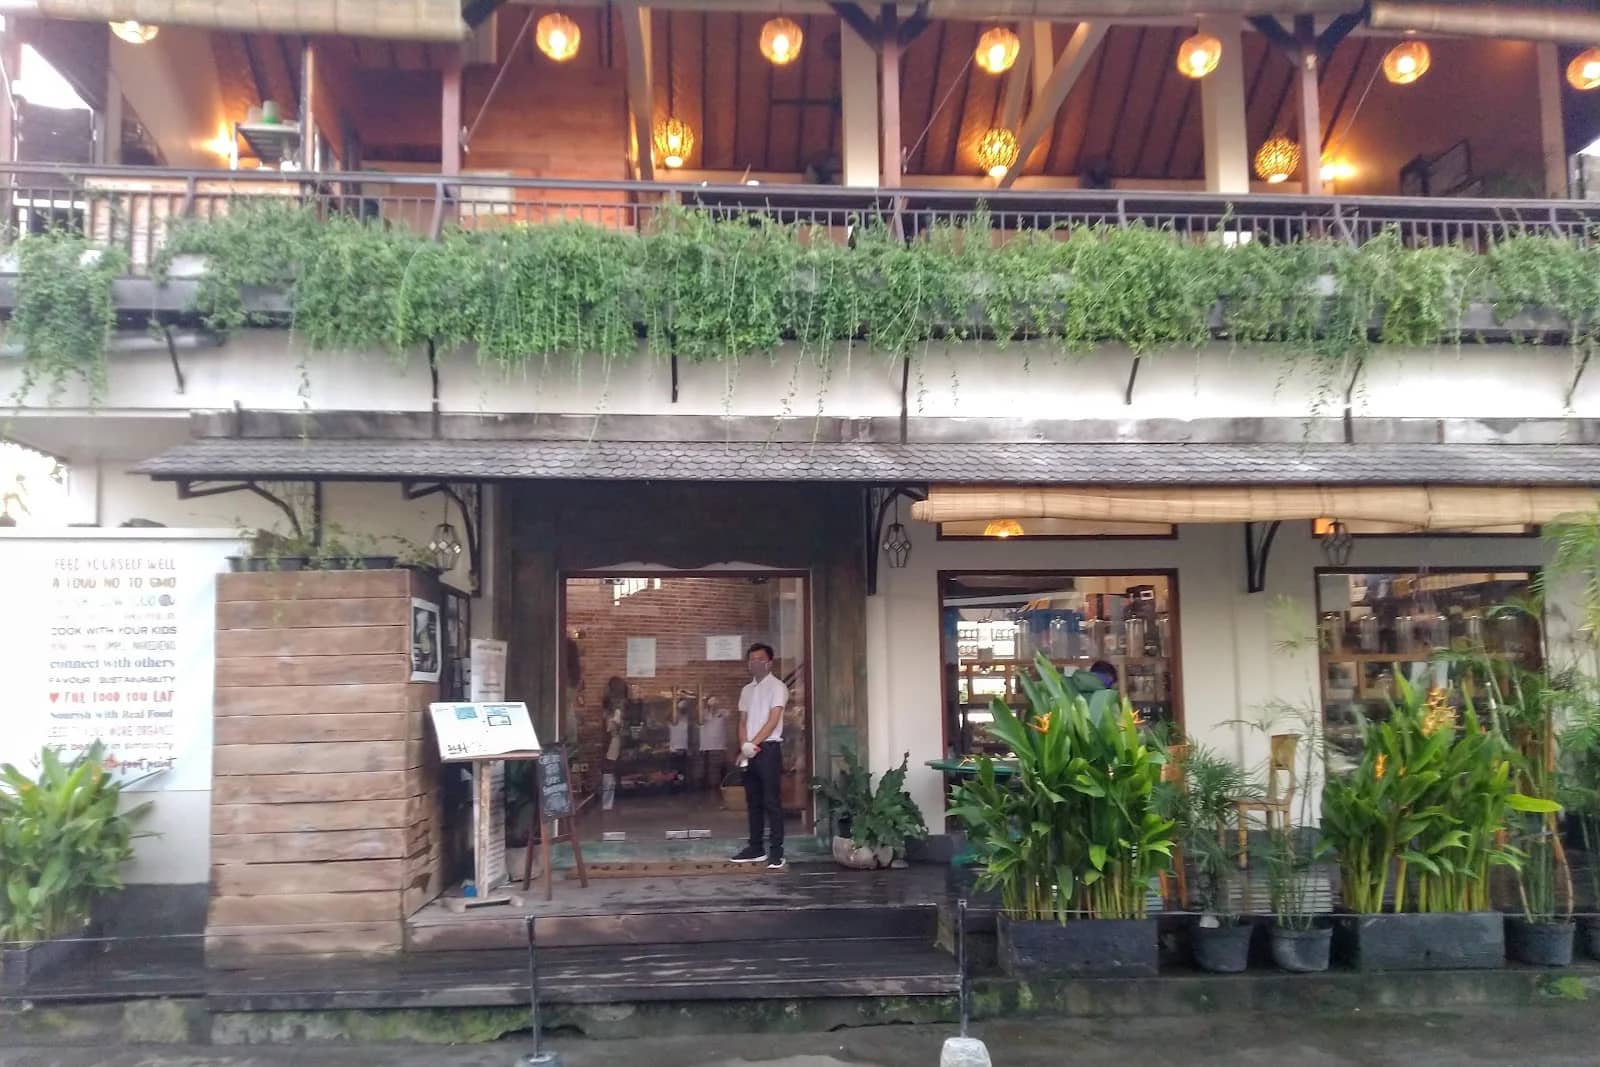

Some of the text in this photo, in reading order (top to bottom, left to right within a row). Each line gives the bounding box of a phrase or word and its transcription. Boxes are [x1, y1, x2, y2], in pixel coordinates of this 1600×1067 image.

[51, 626, 81, 635] COOK
[119, 626, 148, 635] YOUR
[151, 626, 177, 635] KIDS
[50, 656, 175, 669] connect with others
[122, 710, 145, 719] Real
[148, 709, 174, 719] Food
